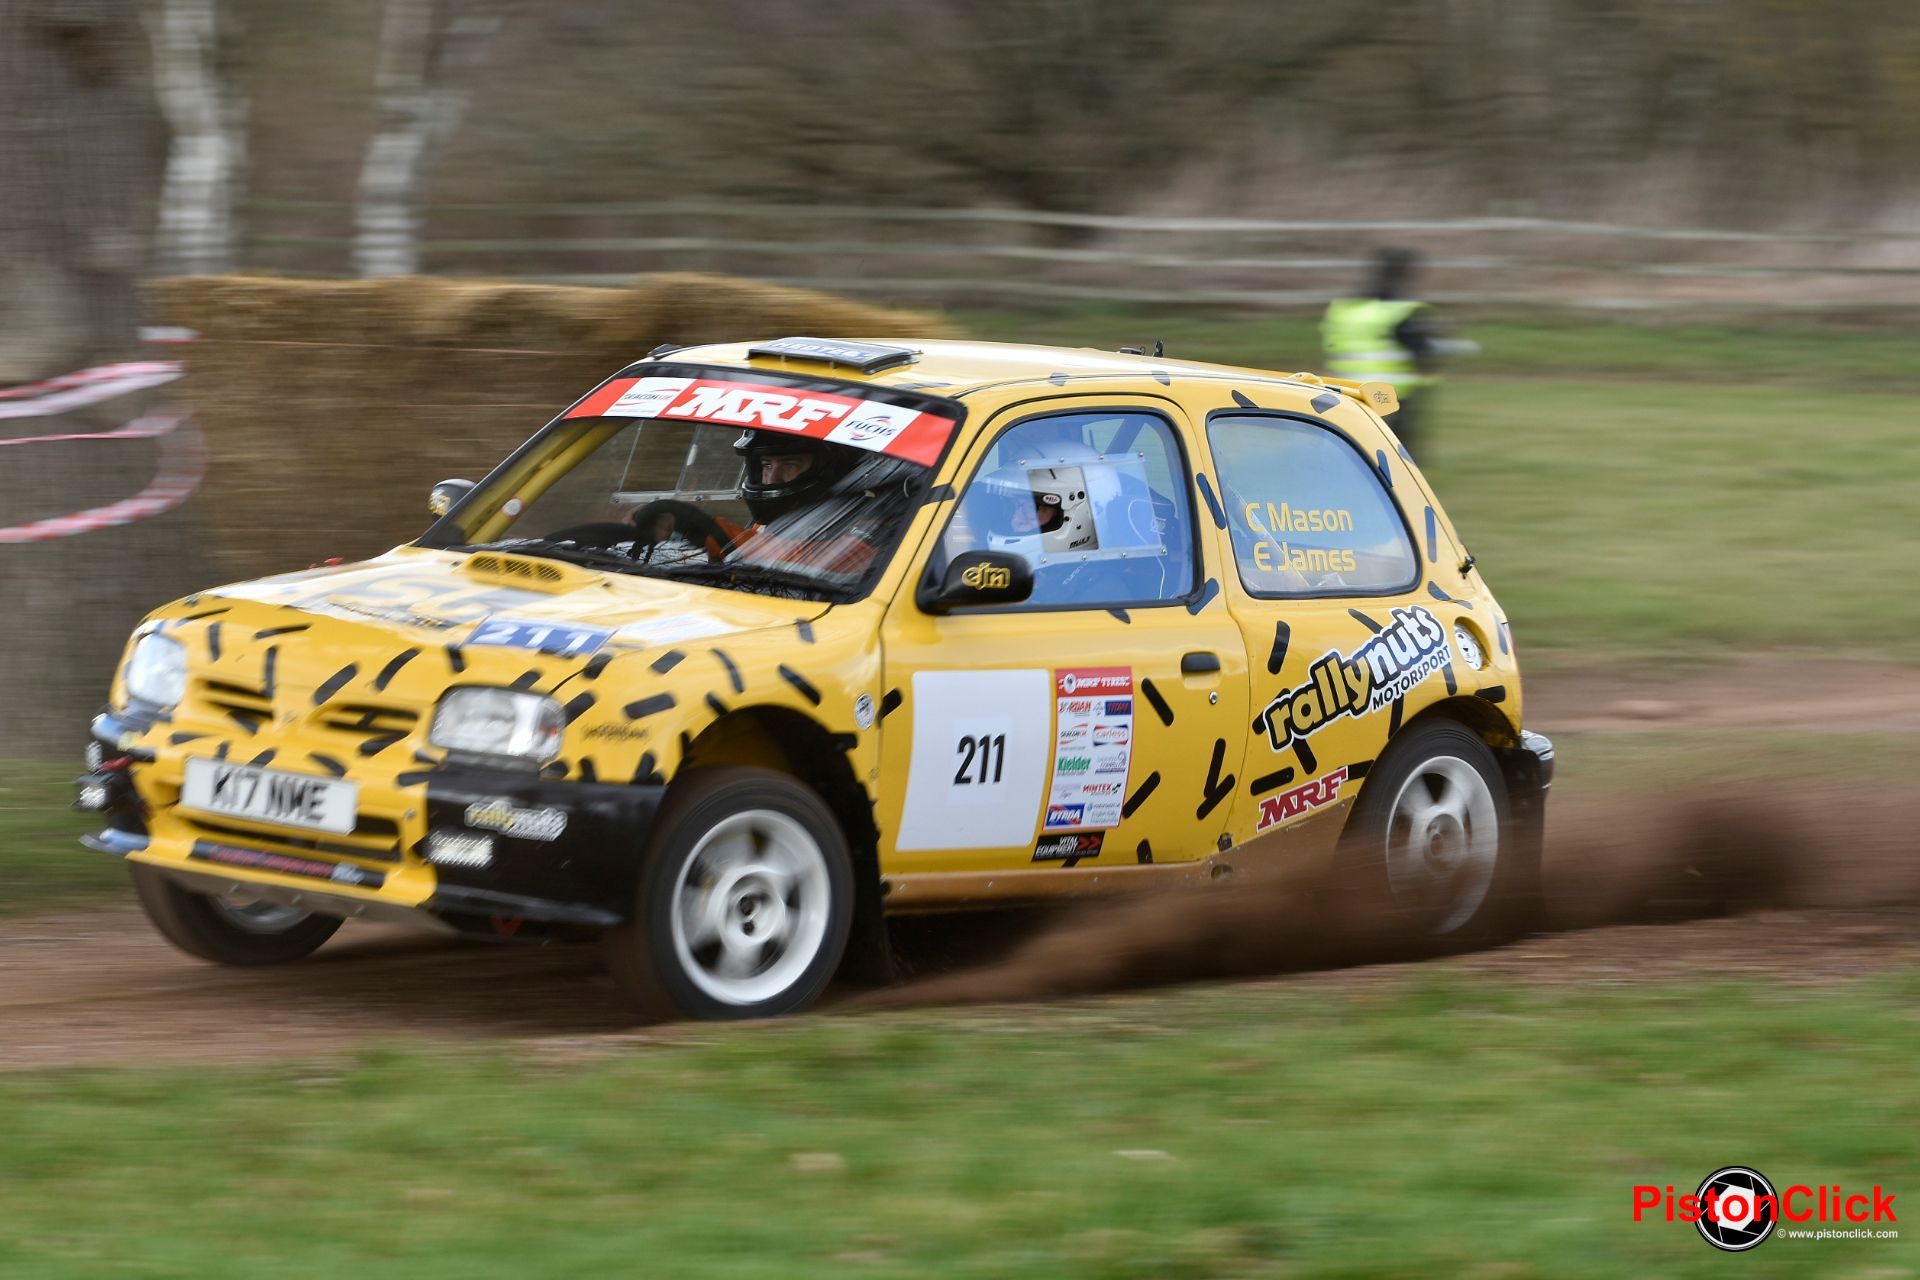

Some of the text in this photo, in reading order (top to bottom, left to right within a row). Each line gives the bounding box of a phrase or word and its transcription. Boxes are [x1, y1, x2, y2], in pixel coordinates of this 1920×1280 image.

[664, 386, 851, 430] MRF
[845, 420, 896, 437] FUCHS
[1245, 503, 1353, 532] C Mason
[1254, 541, 1357, 572] E James
[471, 623, 594, 653] 211
[1267, 607, 1445, 748] rallynuts
[1372, 645, 1452, 710] MOTORSPORT
[953, 734, 1006, 785] 211
[1057, 756, 1091, 771] Kielder
[211, 765, 261, 810] K17
[1257, 768, 1348, 831] MRF
